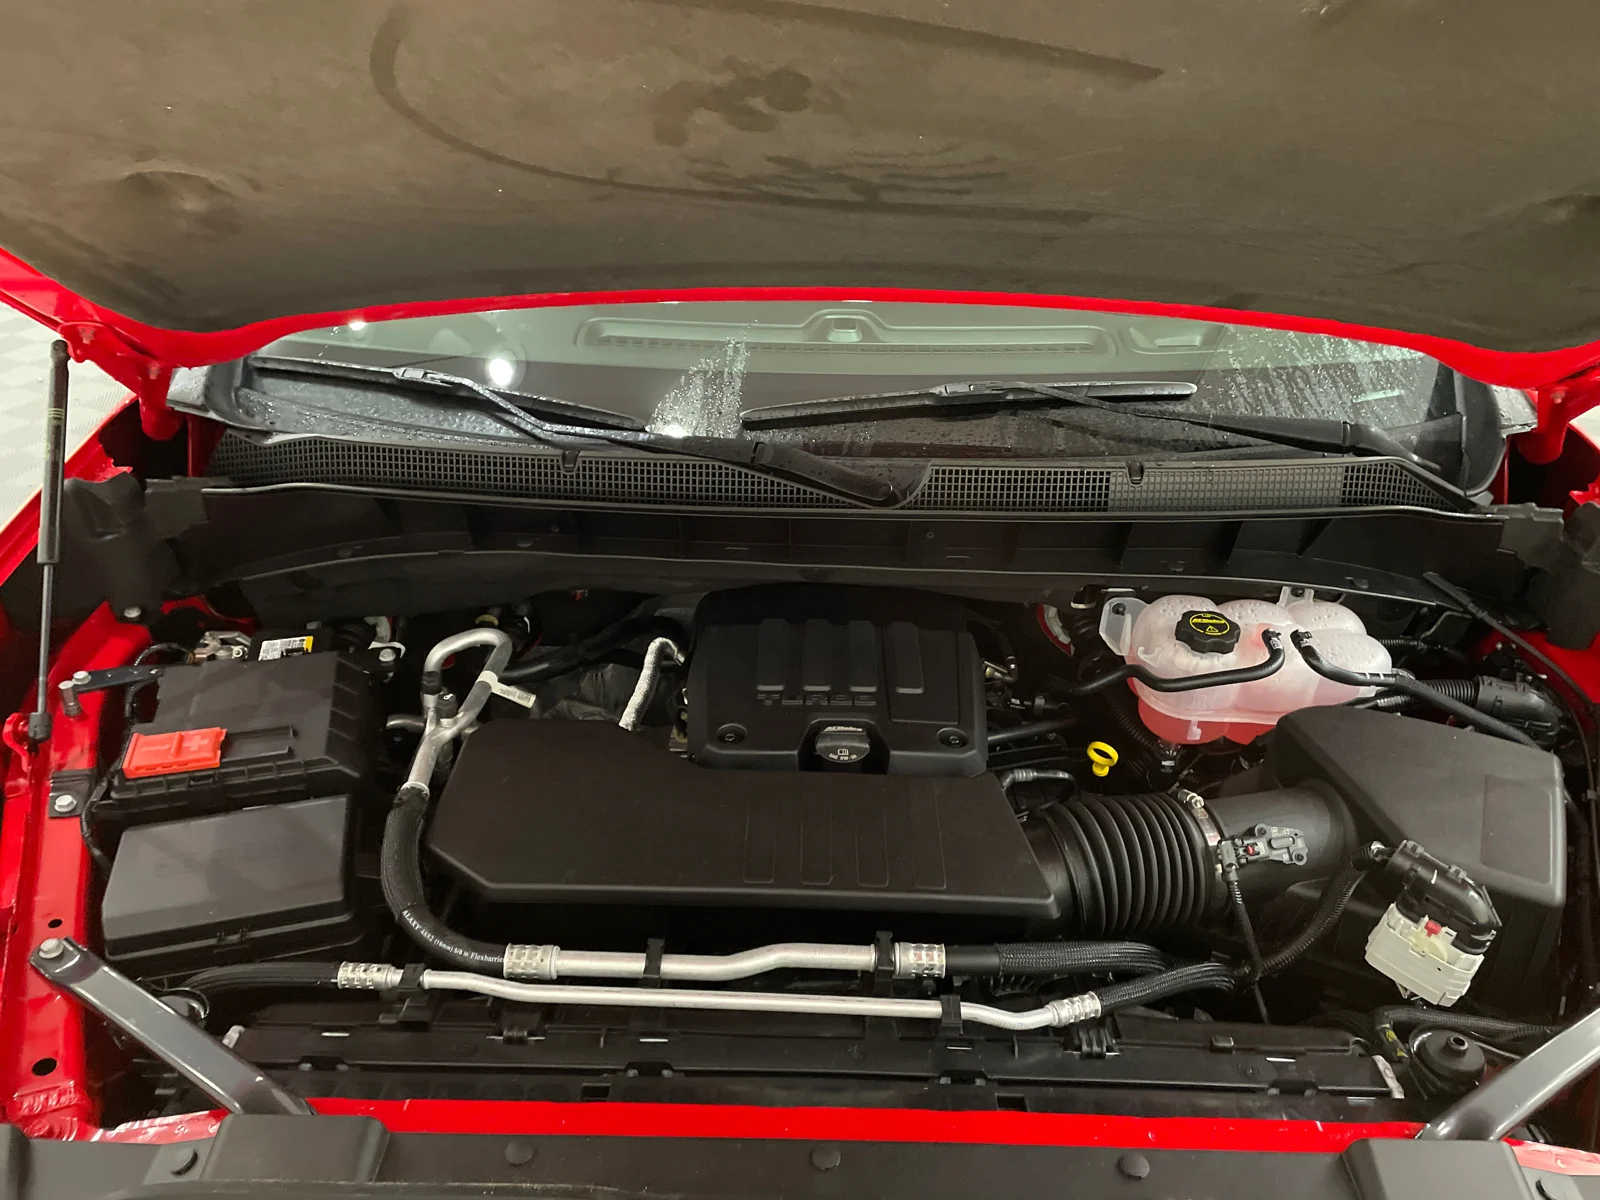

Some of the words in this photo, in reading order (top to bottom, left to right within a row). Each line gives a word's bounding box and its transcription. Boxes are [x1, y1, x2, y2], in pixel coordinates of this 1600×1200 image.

[756, 694, 877, 706] TURBO
[402, 910, 422, 930] ALAXY
[470, 952, 504, 963] Flexbarrie
